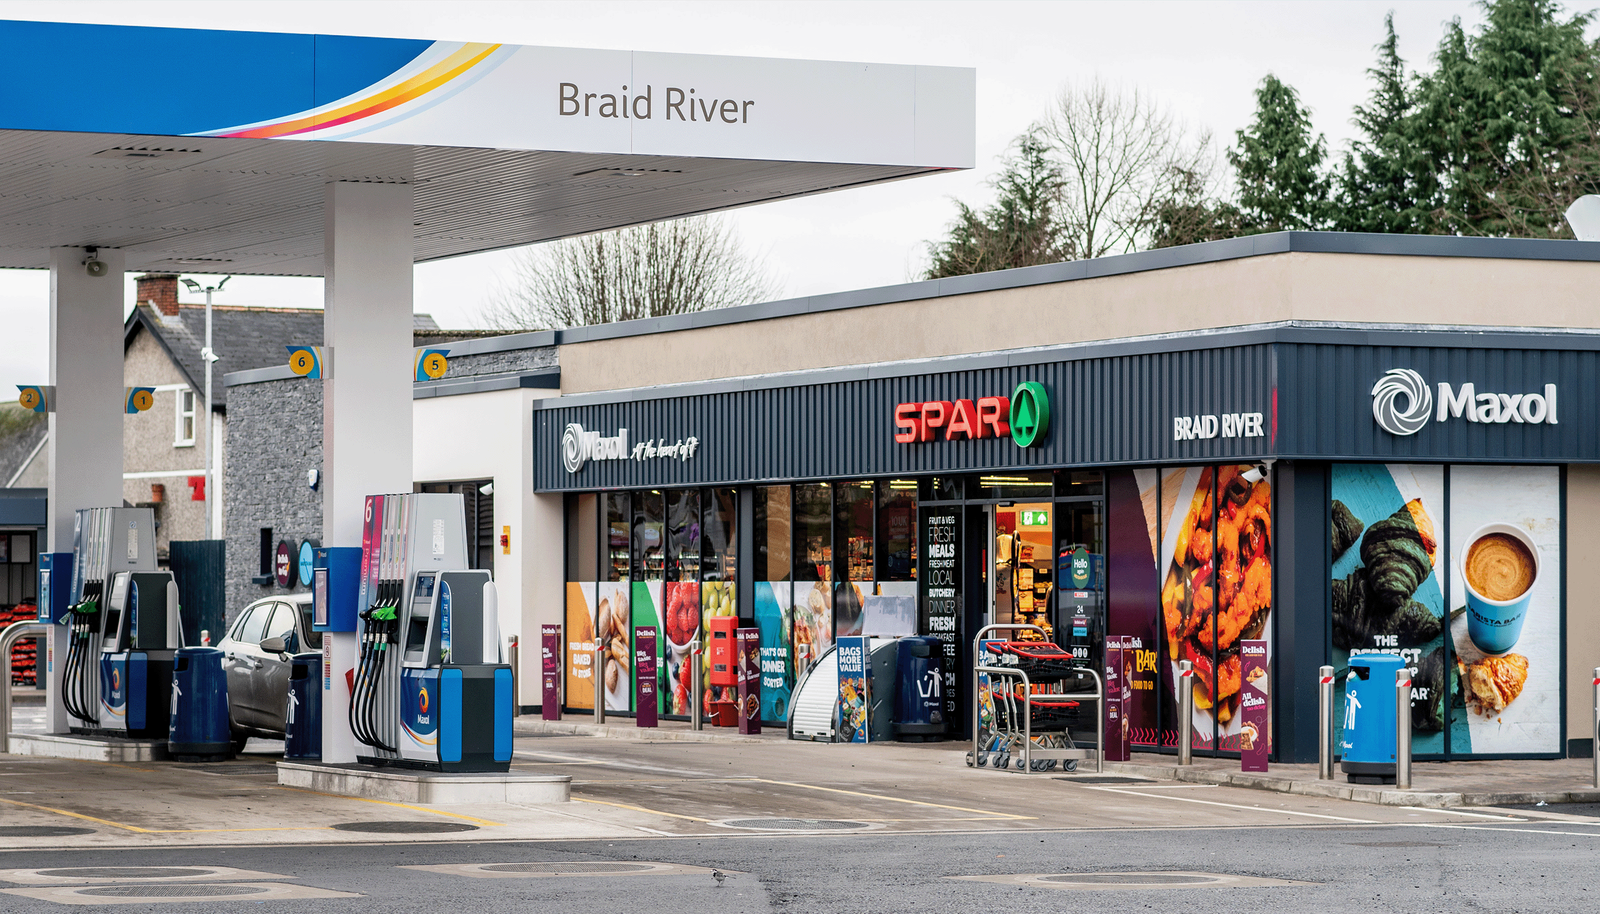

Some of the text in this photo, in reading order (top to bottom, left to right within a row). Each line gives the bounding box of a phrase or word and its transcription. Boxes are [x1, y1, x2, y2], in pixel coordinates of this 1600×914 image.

[559, 82, 755, 124] Braid River
[298, 356, 306, 368] 6
[431, 359, 439, 371] 5
[26, 393, 32, 403] 2
[140, 395, 146, 405] 1
[1437, 382, 1559, 425] Maxol
[894, 396, 1011, 444] SPAR
[1174, 412, 1265, 441] BRAID RIVER
[583, 428, 628, 462] Maxol
[643, 439, 657, 461] the
[657, 438, 682, 459] heart
[365, 498, 373, 523] 6
[928, 516, 941, 525] FRUIT
[945, 516, 955, 524] VEG
[928, 526, 955, 543] FRESH
[928, 544, 955, 558] MEALS
[1073, 559, 1088, 569] Hello
[928, 570, 955, 585] LOCAL
[928, 588, 955, 598] BUTCHERY
[928, 600, 956, 614] DINNER
[928, 616, 955, 631] FRESH
[569, 641, 595, 652] FRESH BREAD
[1106, 641, 1121, 649] Delish
[1373, 634, 1399, 647] THE
[760, 647, 787, 657] THAT'S OUR
[839, 646, 862, 656] BAGS
[1242, 646, 1266, 654] Delish
[573, 653, 591, 666] BAKED
[839, 656, 862, 664] MORE
[572, 666, 592, 679] IN STORE
[761, 660, 786, 673] DINNER
[839, 664, 862, 672] VALUE
[763, 676, 784, 689] SORTED
[1133, 680, 1154, 690] FOOD TO GO
[1242, 692, 1252, 701] All
[1410, 687, 1428, 700] AR
[1242, 697, 1266, 707] delish
